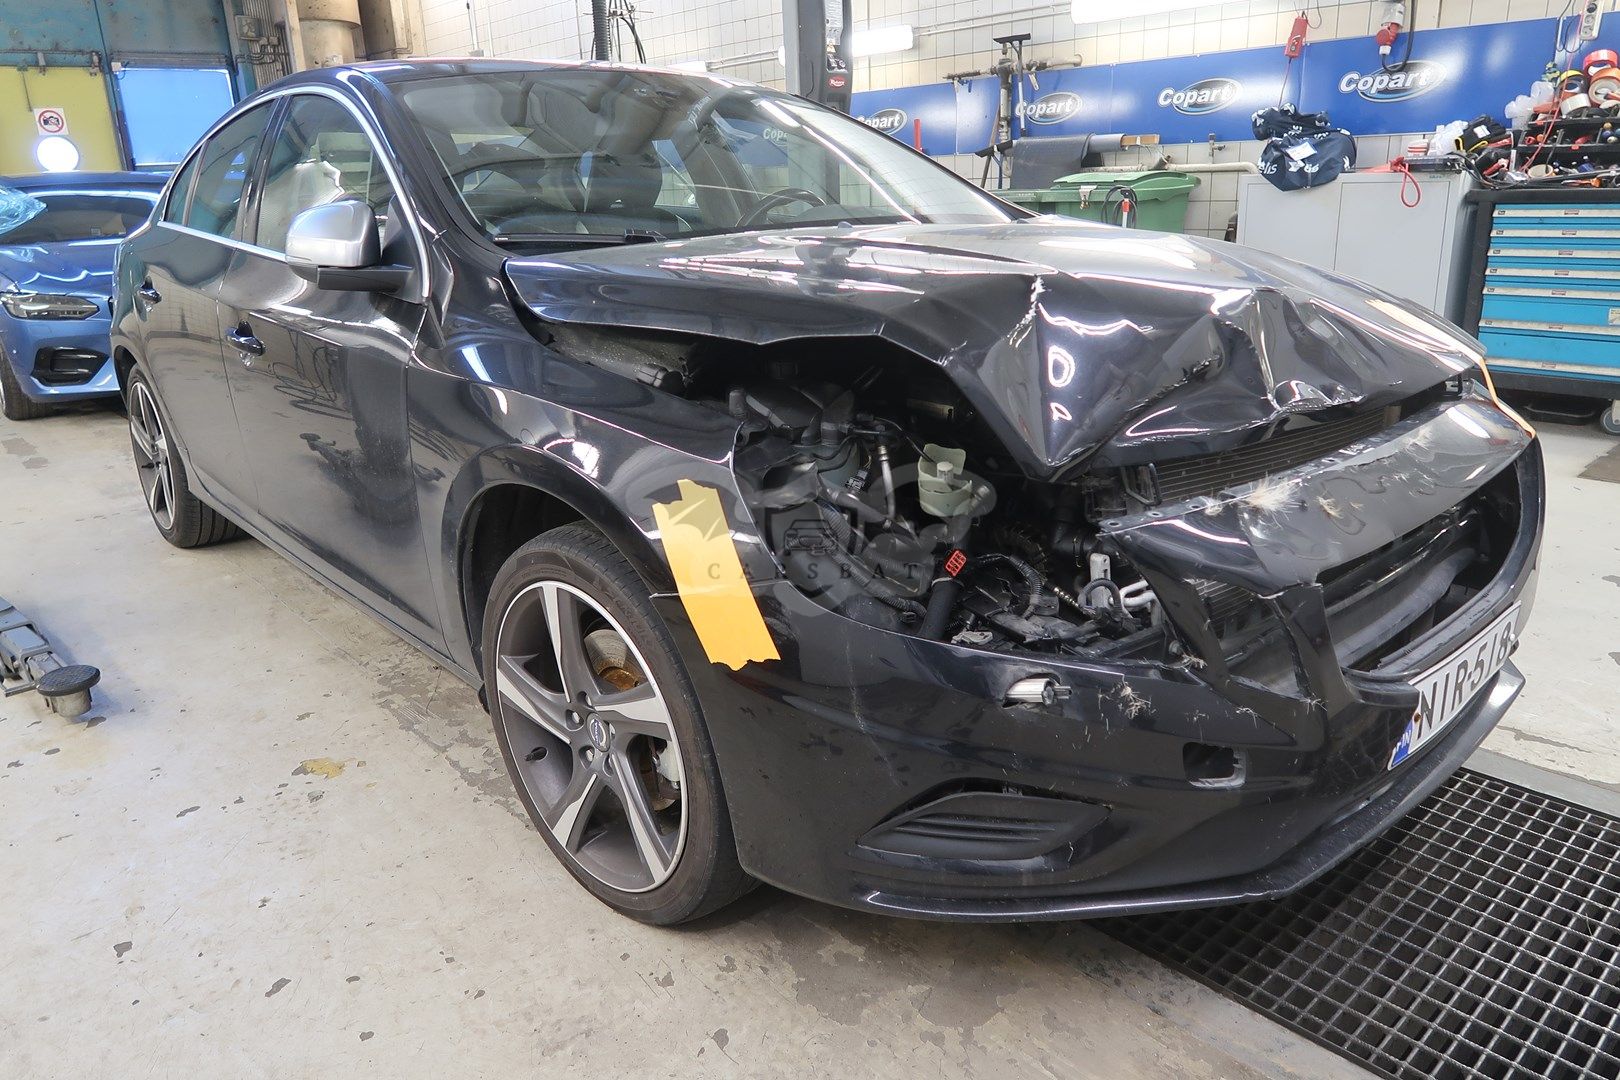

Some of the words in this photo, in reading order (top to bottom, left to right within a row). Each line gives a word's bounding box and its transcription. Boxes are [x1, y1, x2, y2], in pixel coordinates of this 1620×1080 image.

[1340, 68, 1433, 94] Copart
[1015, 96, 1076, 119] Copart
[1158, 84, 1232, 108] Copart
[1416, 621, 1512, 740] NIR-518
